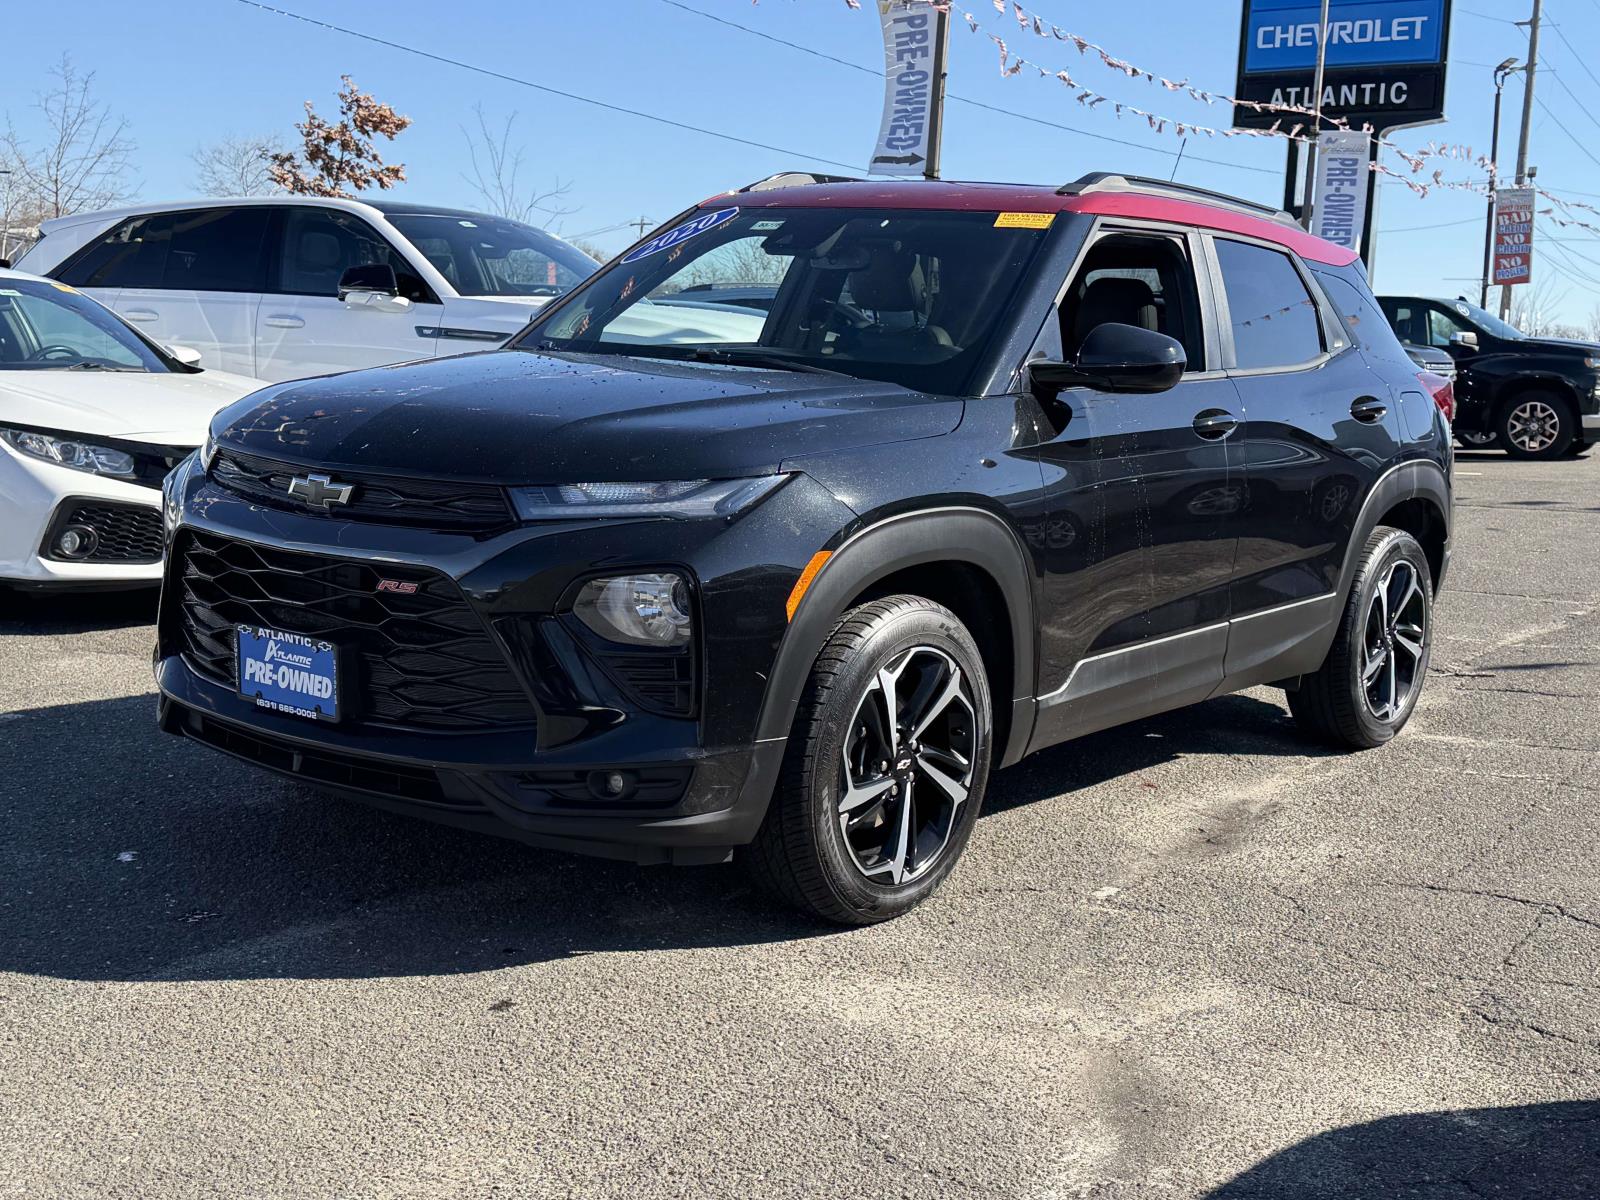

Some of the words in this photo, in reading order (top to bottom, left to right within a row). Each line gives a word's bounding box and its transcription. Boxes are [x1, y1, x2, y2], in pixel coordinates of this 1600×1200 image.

[1257, 16, 1428, 49] CHEVROLET
[885, 13, 929, 151] PRE-OWNED
[1270, 81, 1408, 108] ATLANTIC
[1497, 210, 1532, 225] BAD
[639, 213, 718, 257] 2020
[1499, 223, 1531, 234] CREDIT
[1503, 233, 1525, 246] NO
[1497, 243, 1532, 254] CREDIT
[1499, 256, 1522, 269] NO
[377, 579, 419, 594] RS
[257, 627, 312, 648] ATLANTIC
[244, 657, 333, 699] PRE-OWNED
[256, 698, 277, 710] (631)
